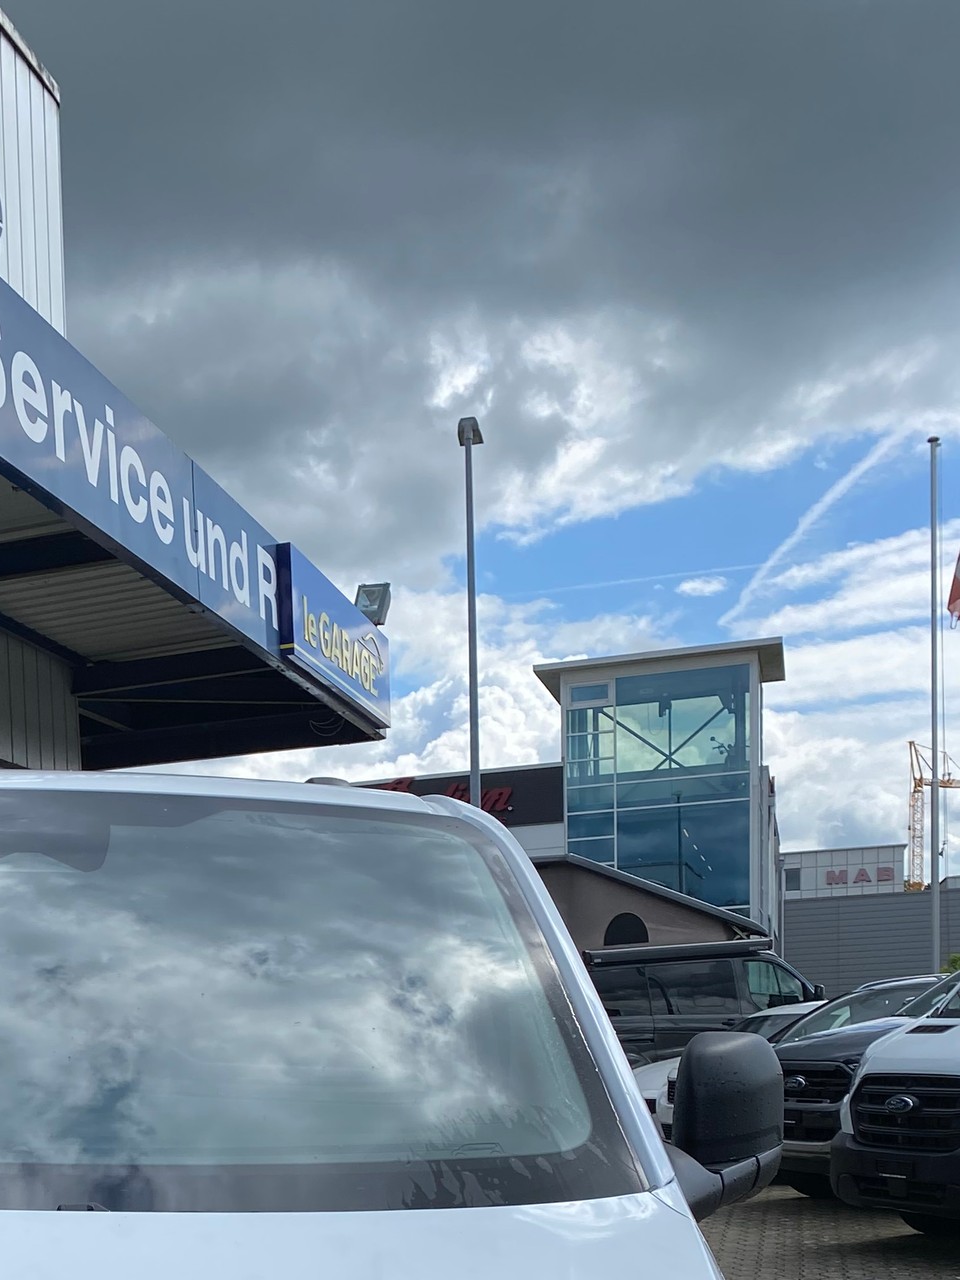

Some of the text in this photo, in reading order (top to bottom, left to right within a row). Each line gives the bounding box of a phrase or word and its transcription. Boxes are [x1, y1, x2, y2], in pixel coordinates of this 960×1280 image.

[183, 496, 251, 608] und
[302, 594, 379, 697] le GARAGE
